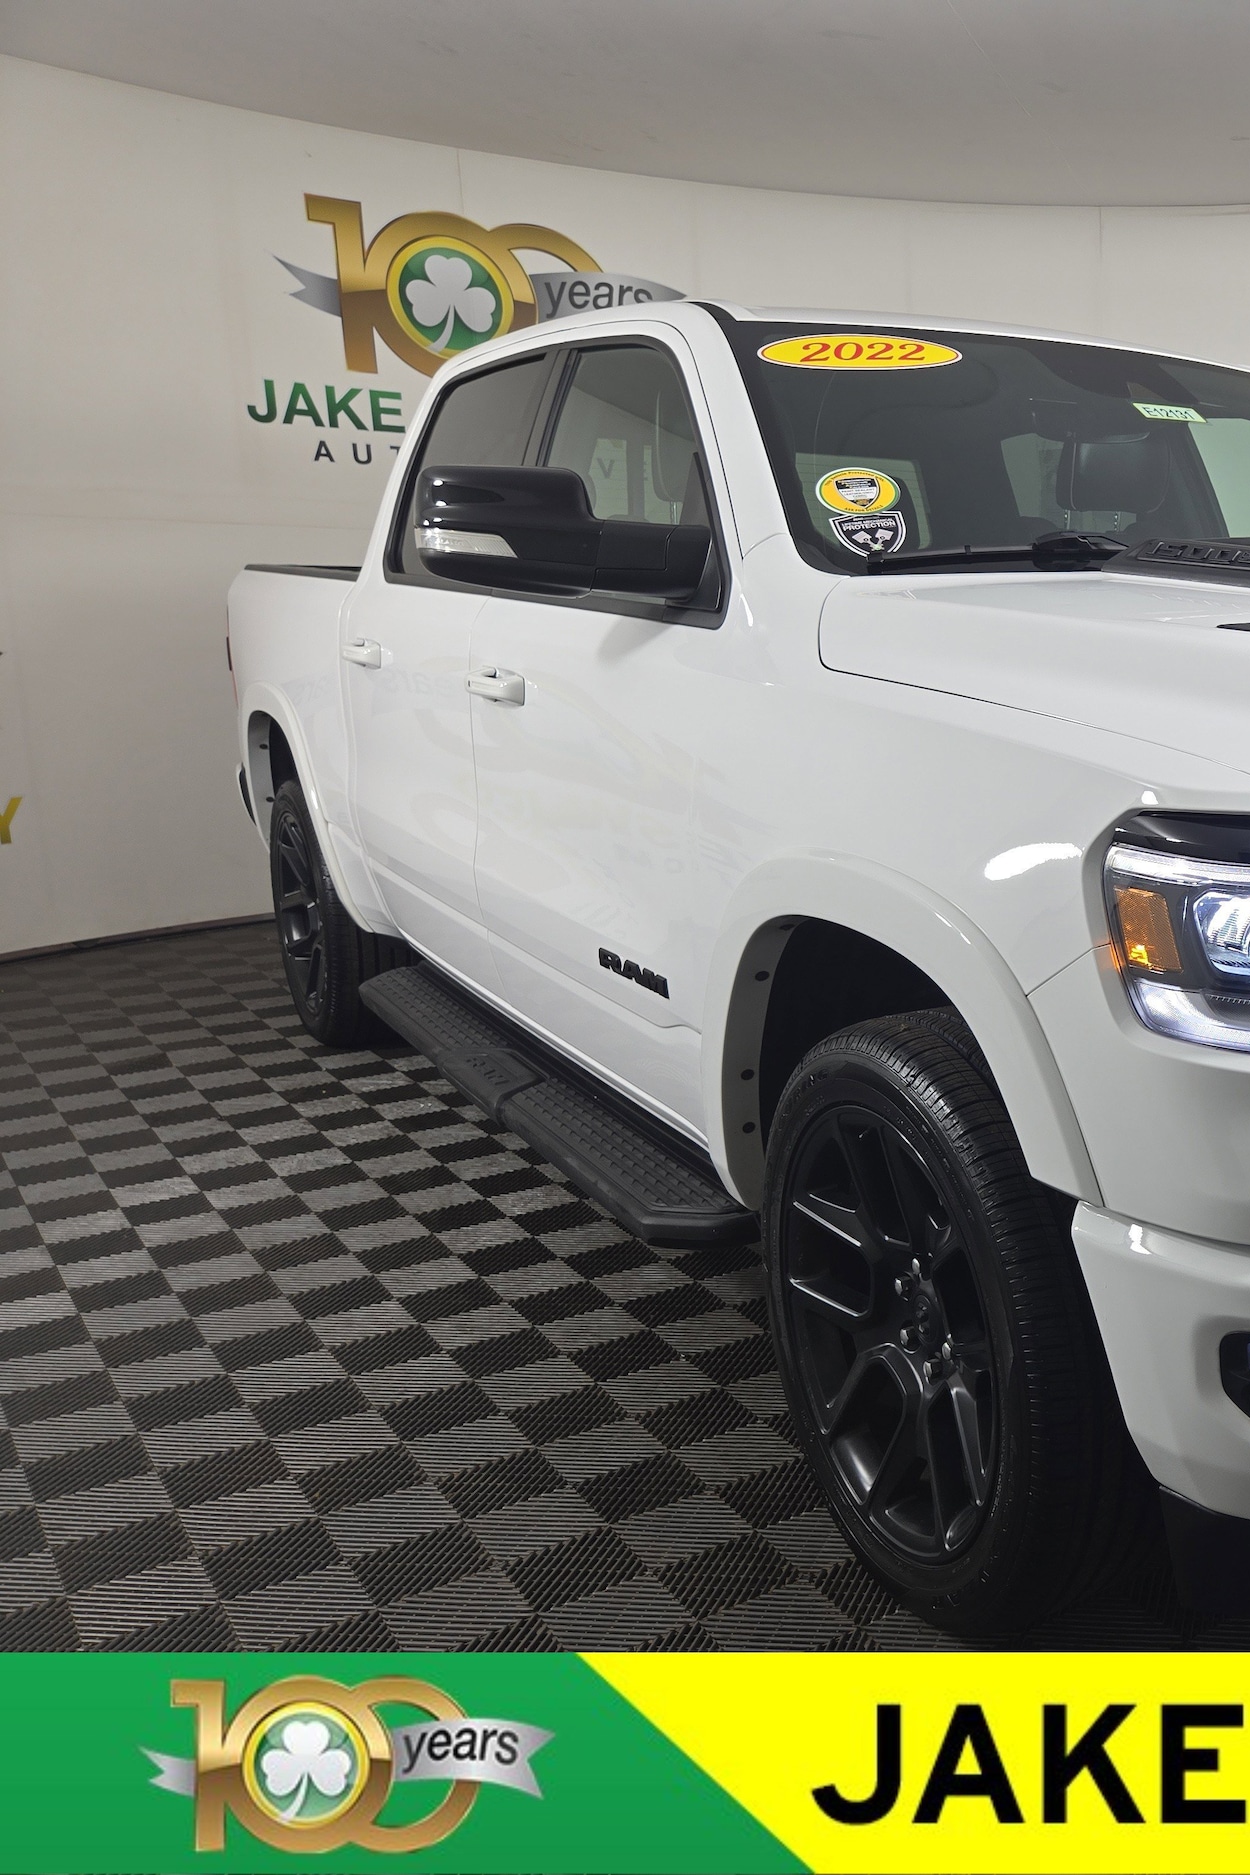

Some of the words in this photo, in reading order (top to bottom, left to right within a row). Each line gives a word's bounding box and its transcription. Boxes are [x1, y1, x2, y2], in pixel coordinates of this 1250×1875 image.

[544, 281, 652, 318] years
[800, 340, 926, 364] 2022
[247, 379, 406, 433] JAKE
[1142, 406, 1195, 420] E12131
[842, 520, 896, 531] PROTECTION
[598, 947, 670, 1000] RAM
